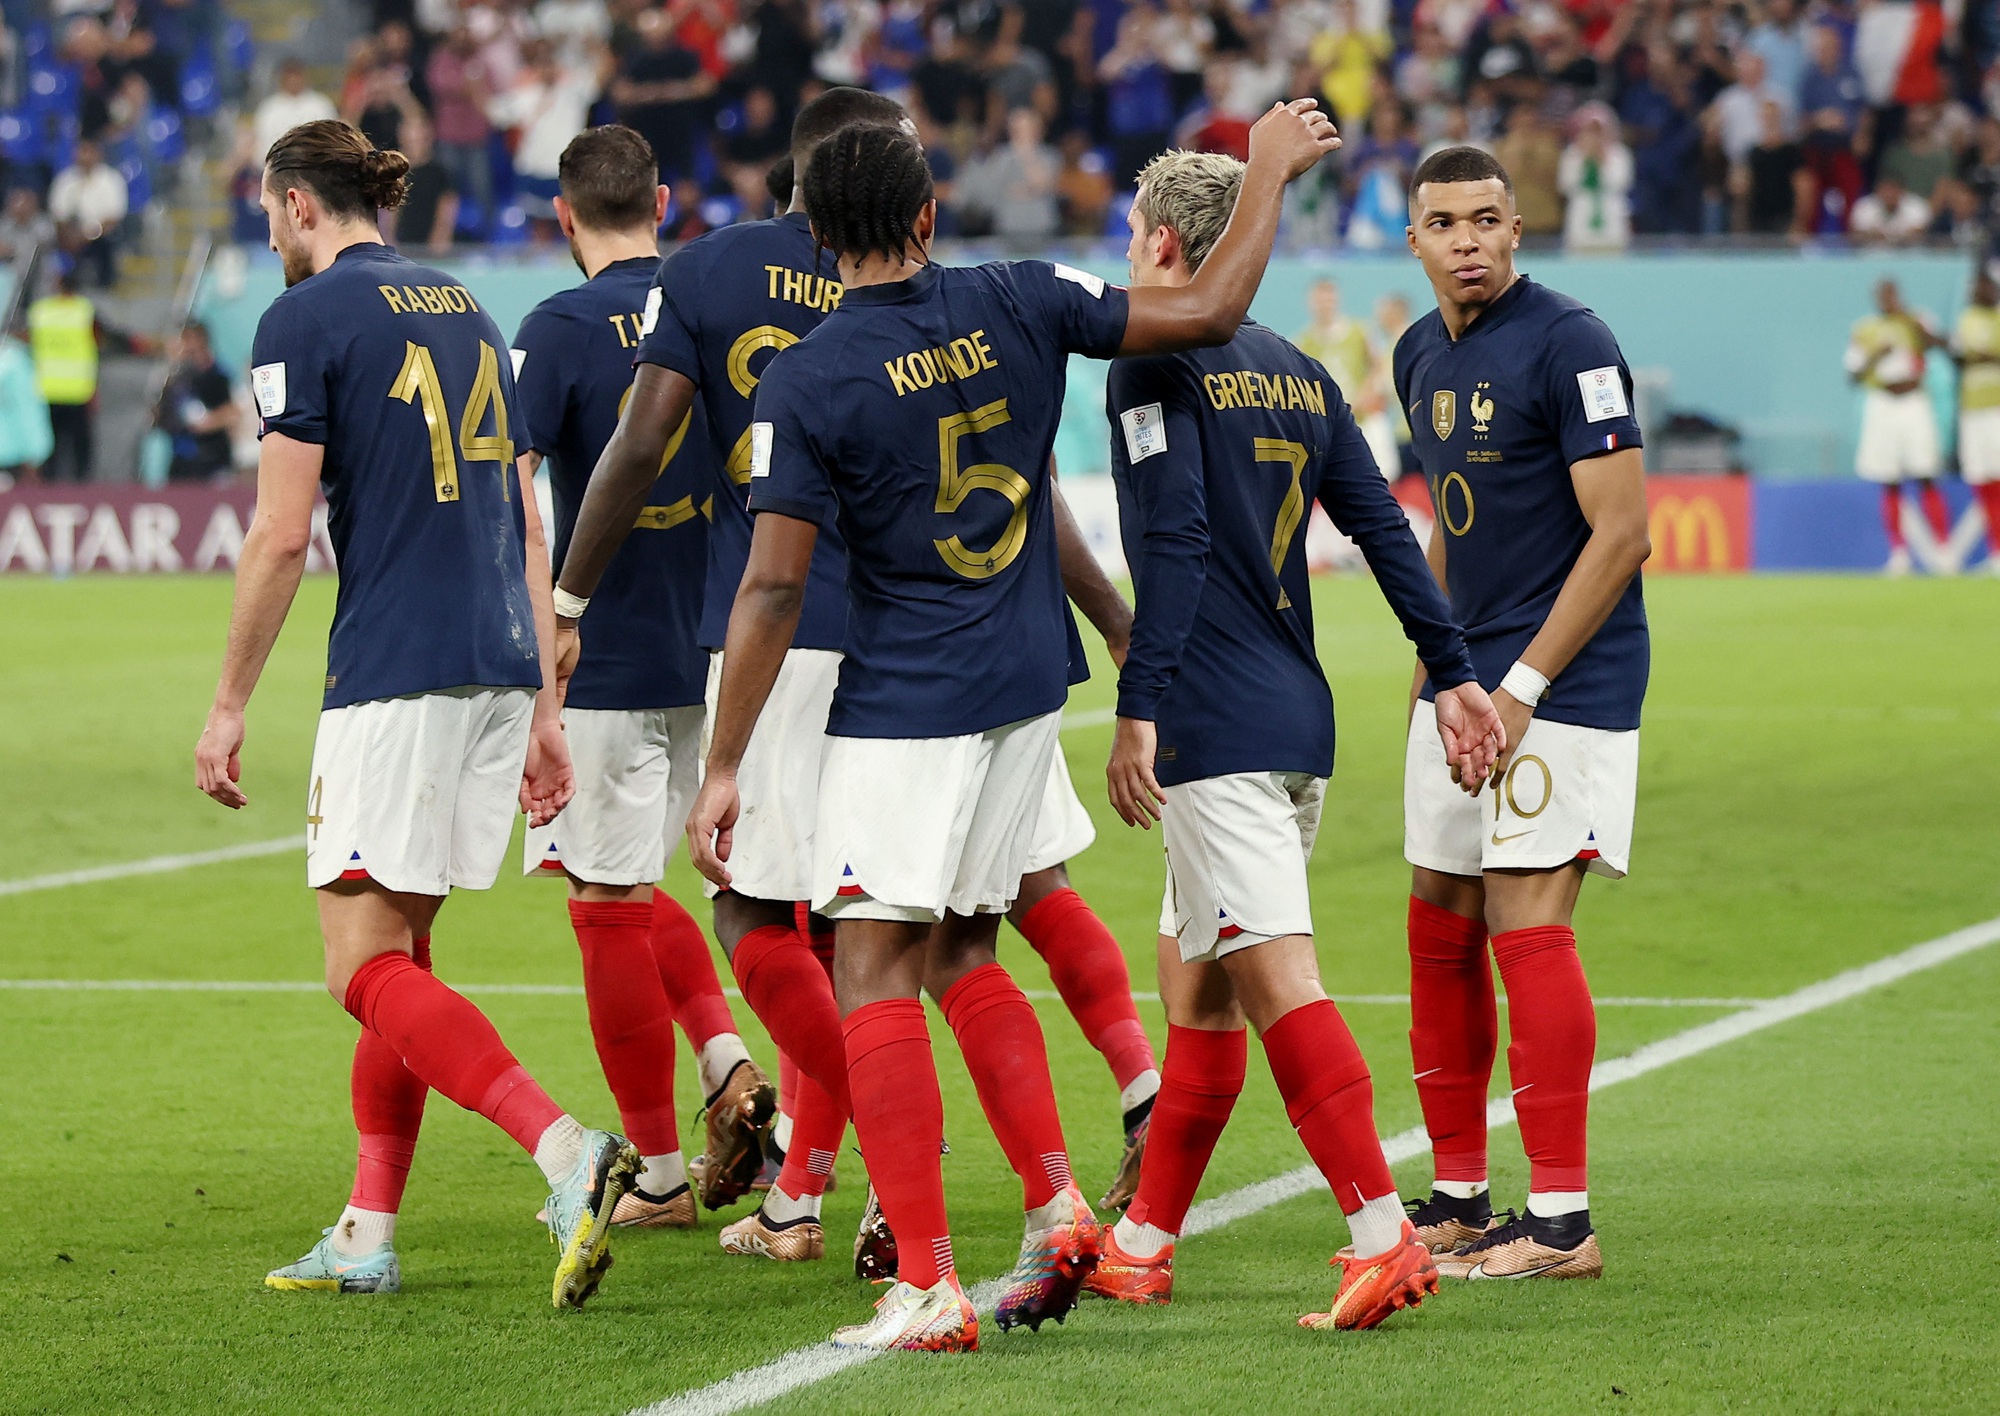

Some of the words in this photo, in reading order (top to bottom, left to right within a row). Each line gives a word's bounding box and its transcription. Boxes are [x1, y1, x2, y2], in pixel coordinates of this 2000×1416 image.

[378, 285, 479, 314] RABIOT
[883, 329, 998, 397] KOUNDE
[387, 339, 515, 503] 14
[933, 397, 1031, 579] 5
[1432, 471, 1475, 537] 10
[1252, 437, 1309, 610] 7
[1488, 754, 1552, 821] 10
